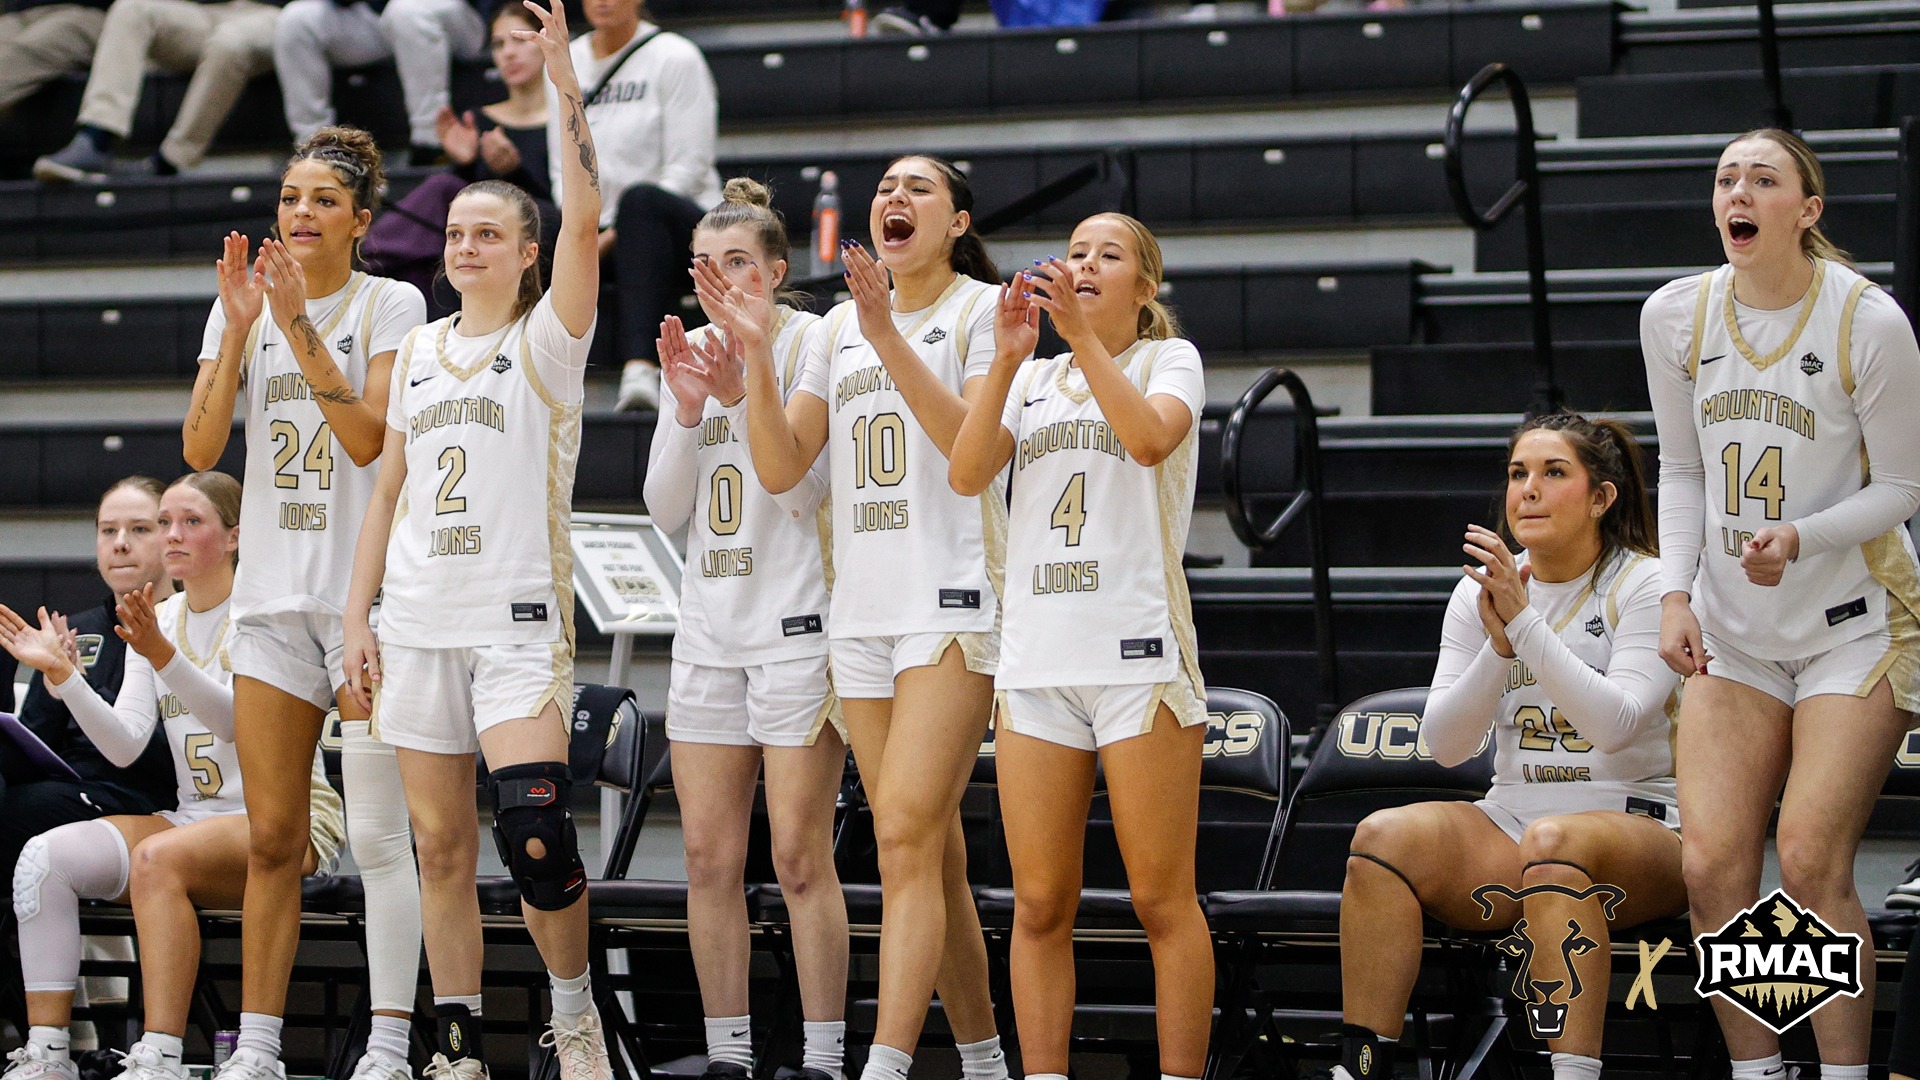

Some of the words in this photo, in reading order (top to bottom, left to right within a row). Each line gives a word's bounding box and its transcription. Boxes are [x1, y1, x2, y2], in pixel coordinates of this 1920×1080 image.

[1701, 389, 1815, 440] MOUNTAIN
[270, 418, 334, 491] 24
[436, 444, 467, 516] 2
[852, 412, 906, 489] 10
[1722, 441, 1785, 521] 14
[279, 502, 326, 531] IONS
[709, 464, 743, 536] 0
[853, 500, 908, 533] LIONS
[1050, 472, 1087, 547] 4
[701, 547, 752, 578] LIONS
[1033, 561, 1098, 595] LIONS
[185, 731, 224, 796] 5
